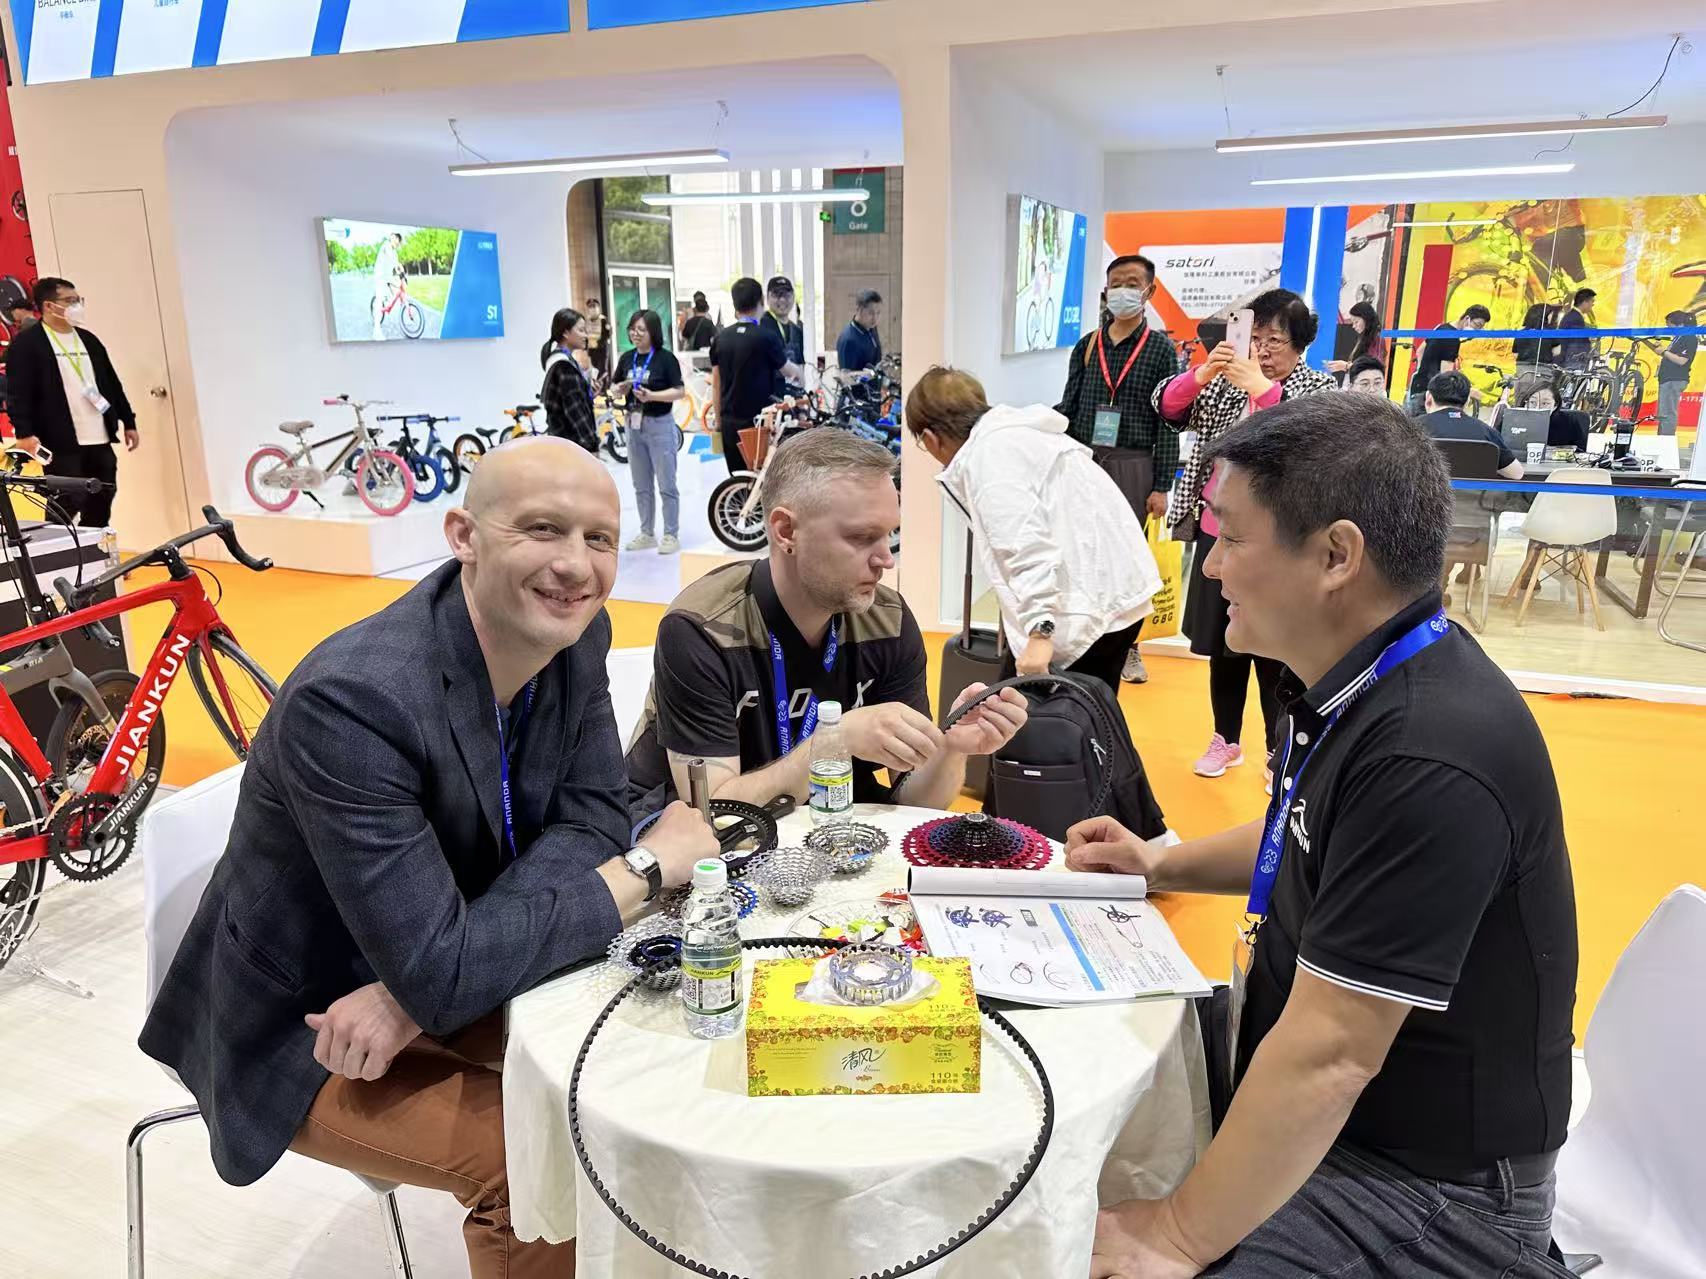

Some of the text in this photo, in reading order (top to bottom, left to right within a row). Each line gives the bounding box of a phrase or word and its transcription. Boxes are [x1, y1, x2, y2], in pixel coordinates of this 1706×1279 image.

[38, 0, 77, 8] BALAN
[848, 221, 868, 230] Gate
[1165, 256, 1216, 268] satori
[487, 305, 498, 320] S1
[114, 634, 191, 775] JIANKUN
[736, 679, 875, 719] FOX
[1336, 671, 1379, 719] ANANDA
[802, 701, 818, 738] ANANDA
[108, 783, 148, 831] JIANKUN
[502, 780, 512, 824] ANANDA
[1271, 799, 1291, 847] ANANDA
[841, 1047, 886, 1071] 清风
